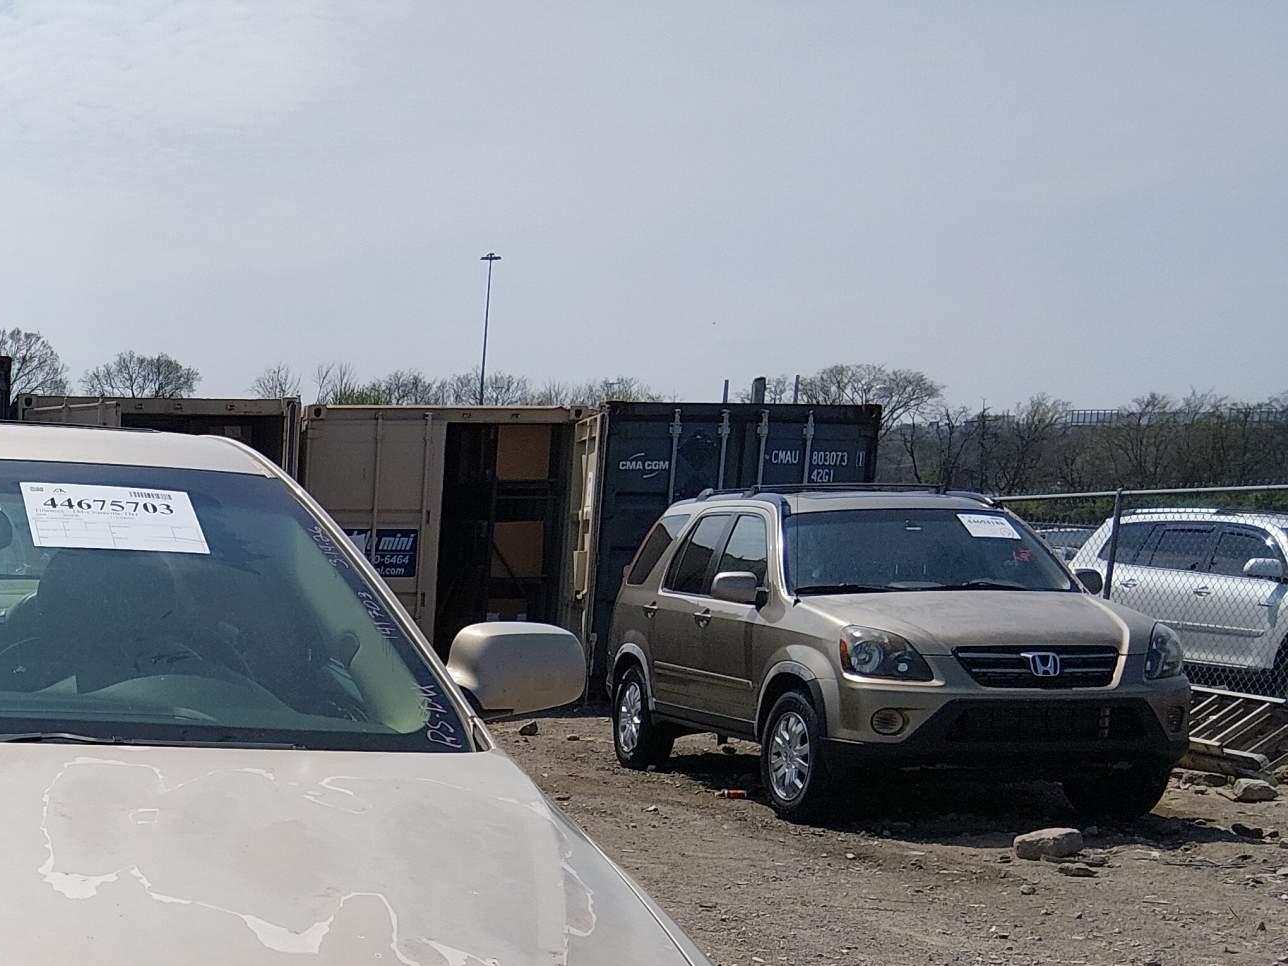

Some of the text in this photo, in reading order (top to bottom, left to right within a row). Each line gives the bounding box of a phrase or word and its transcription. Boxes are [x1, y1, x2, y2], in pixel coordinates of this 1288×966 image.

[619, 461, 670, 470] CMA CGM
[772, 450, 800, 464] CMAU
[812, 451, 848, 467] 803073
[811, 468, 834, 482] 42G1
[43, 497, 175, 516] 44675703
[378, 533, 416, 550] mini
